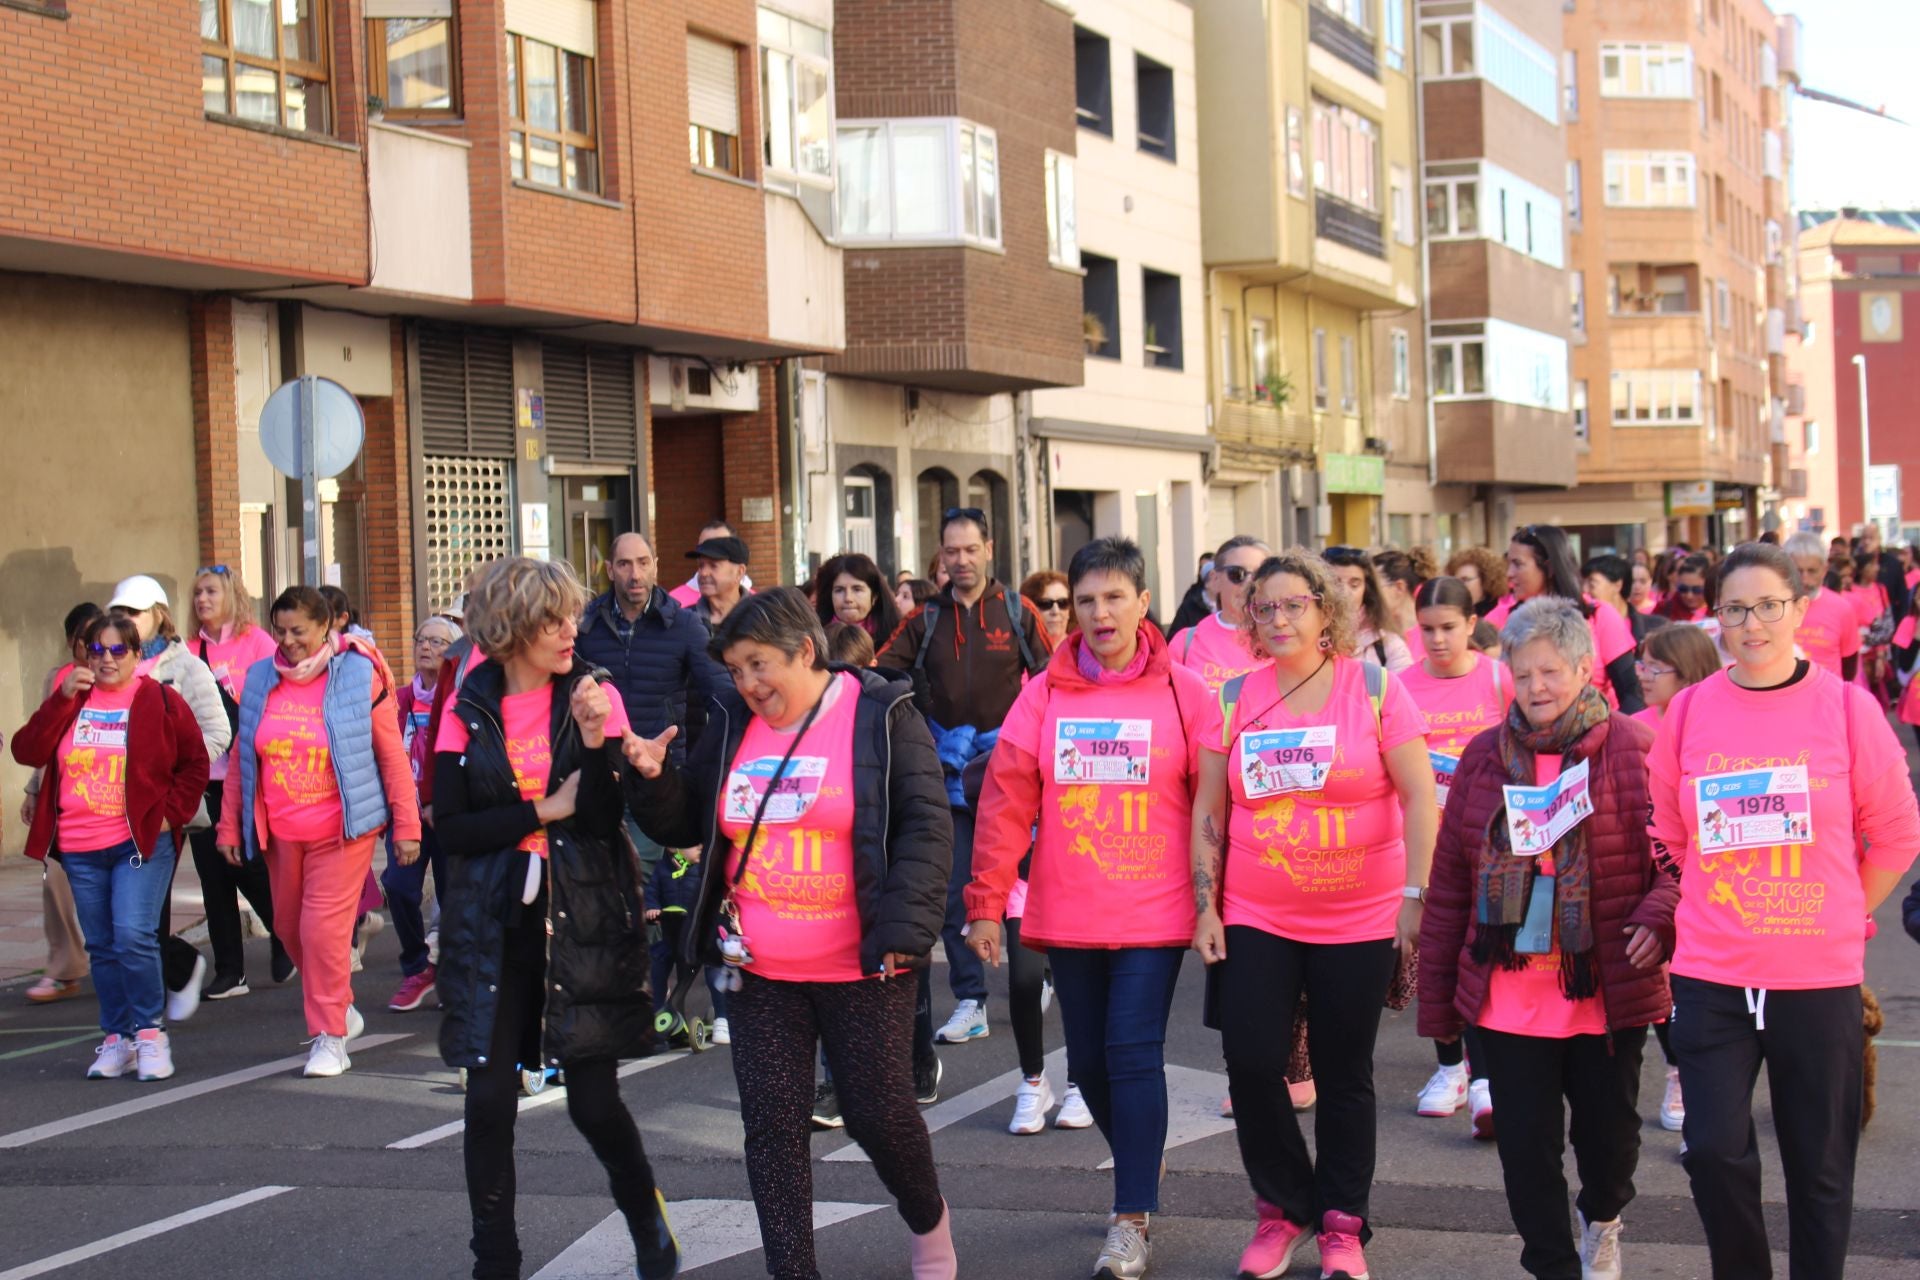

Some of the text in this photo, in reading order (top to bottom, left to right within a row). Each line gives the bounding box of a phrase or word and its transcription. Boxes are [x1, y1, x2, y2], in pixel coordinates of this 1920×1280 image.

[1090, 741, 1129, 755] 1975
[1274, 748, 1314, 764] 1976
[1081, 761, 1094, 778] 11
[1269, 770, 1284, 788] 11
[1544, 789, 1571, 821] 1977
[1737, 795, 1785, 815] 1978
[1100, 832, 1166, 849] Carrera
[1728, 823, 1743, 843] 11
[1119, 847, 1166, 865] Mujer
[1293, 846, 1366, 862] Carrera
[1314, 858, 1365, 876] Mujer
[766, 870, 847, 889] Carrera
[1107, 872, 1166, 881] DRASANVI
[1312, 876, 1345, 885] almom
[788, 888, 846, 903] Mujer
[1302, 881, 1366, 893] DRASANVI
[1743, 877, 1825, 898] Carrera
[777, 911, 847, 920] DRASANVI
[1766, 897, 1824, 917] Mujer
[1763, 916, 1800, 925] almom
[1752, 927, 1825, 935] DRASANVI
